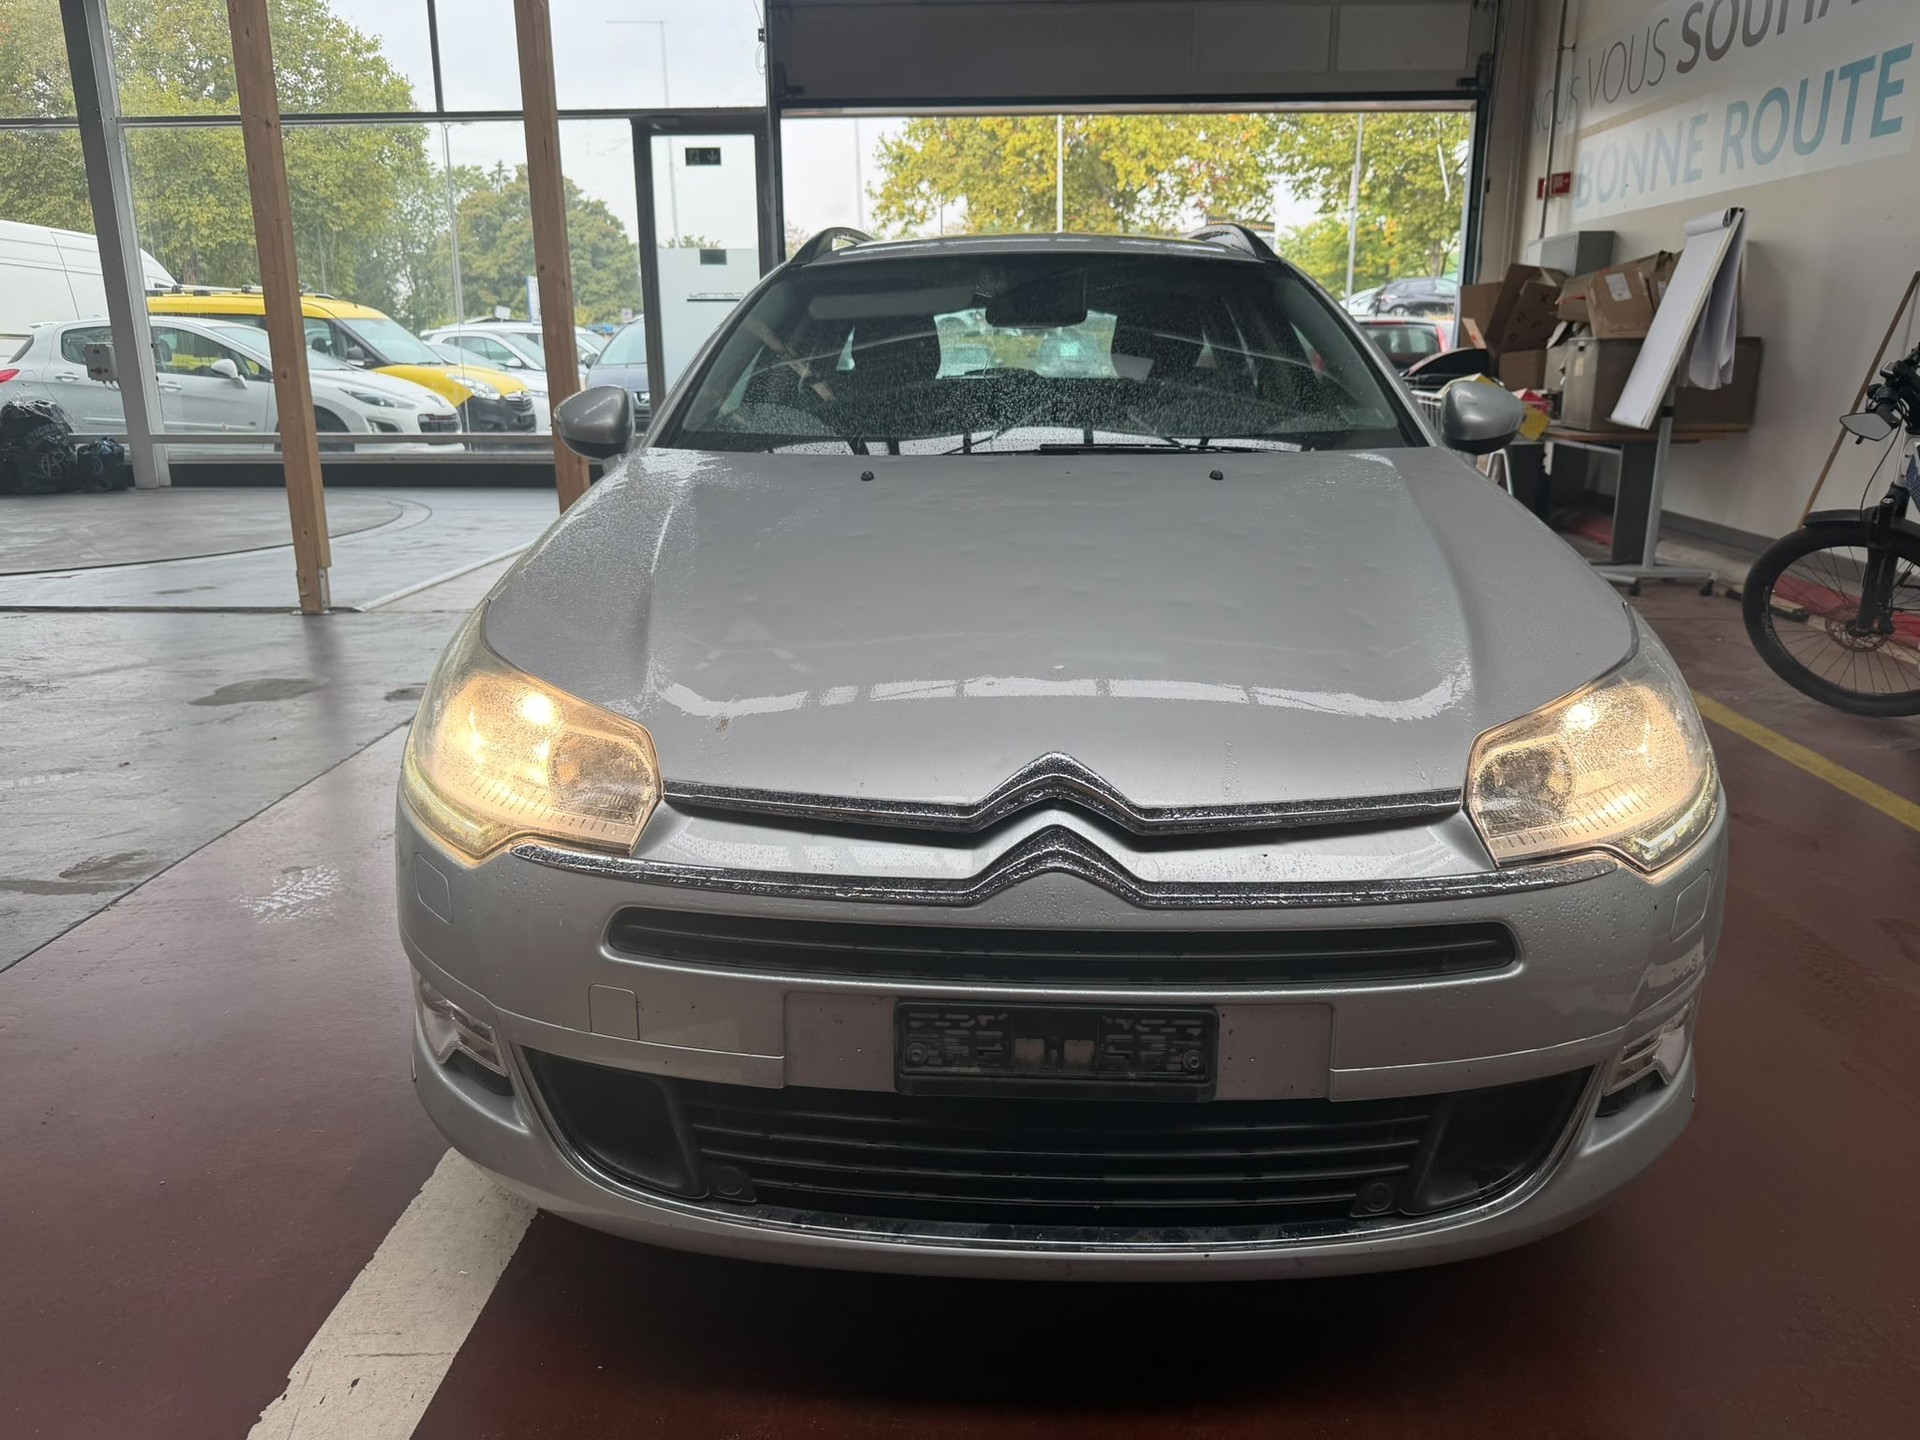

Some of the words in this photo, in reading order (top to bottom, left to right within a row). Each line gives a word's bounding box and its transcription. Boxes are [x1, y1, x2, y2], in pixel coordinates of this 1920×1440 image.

[1575, 111, 1709, 209] BONNE
[1718, 42, 1914, 175] ROUTE
[1588, 18, 1669, 109] VOUS
